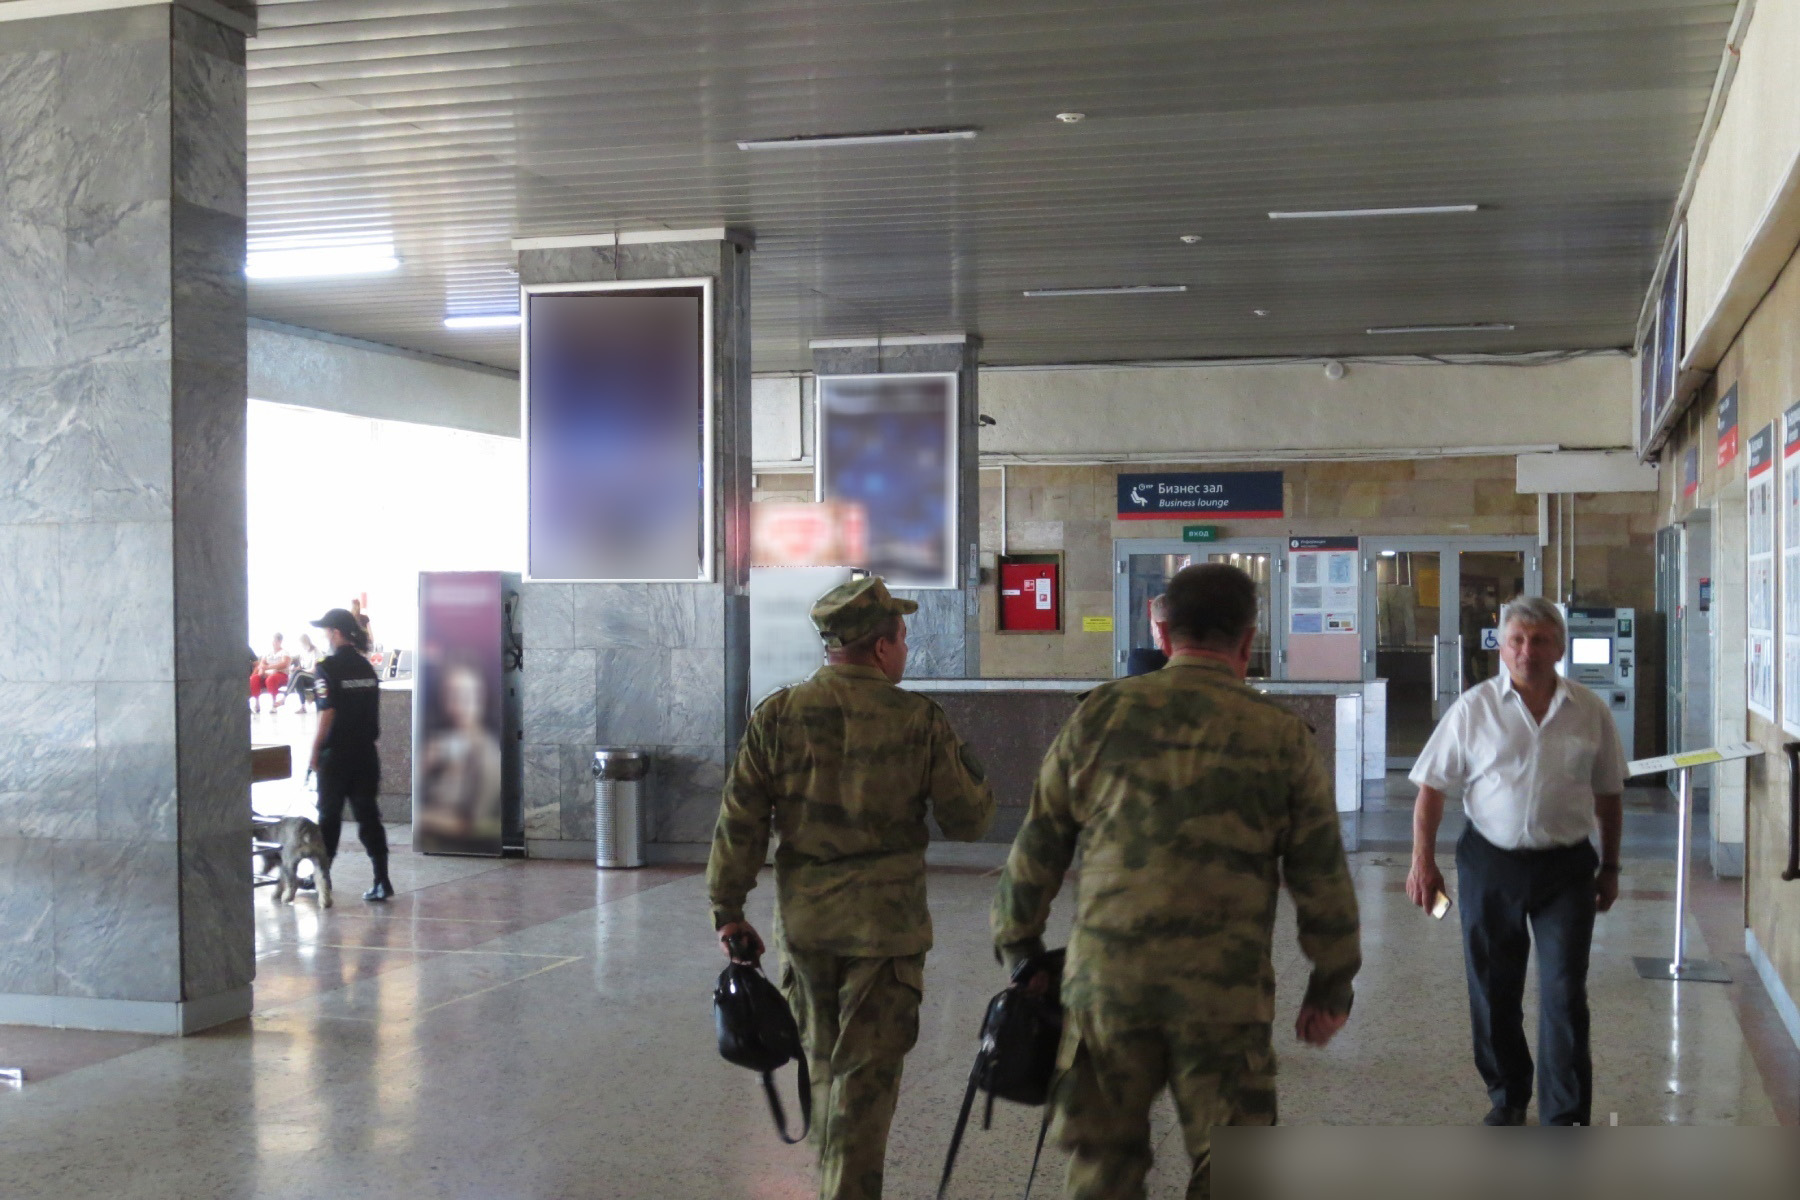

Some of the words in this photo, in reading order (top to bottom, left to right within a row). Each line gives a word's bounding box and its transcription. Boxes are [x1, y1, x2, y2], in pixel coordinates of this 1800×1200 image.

[1158, 483, 1200, 494] Бизнес
[1203, 484, 1223, 493] зал
[1159, 498, 1195, 507] Business
[1197, 498, 1229, 508] lounge
